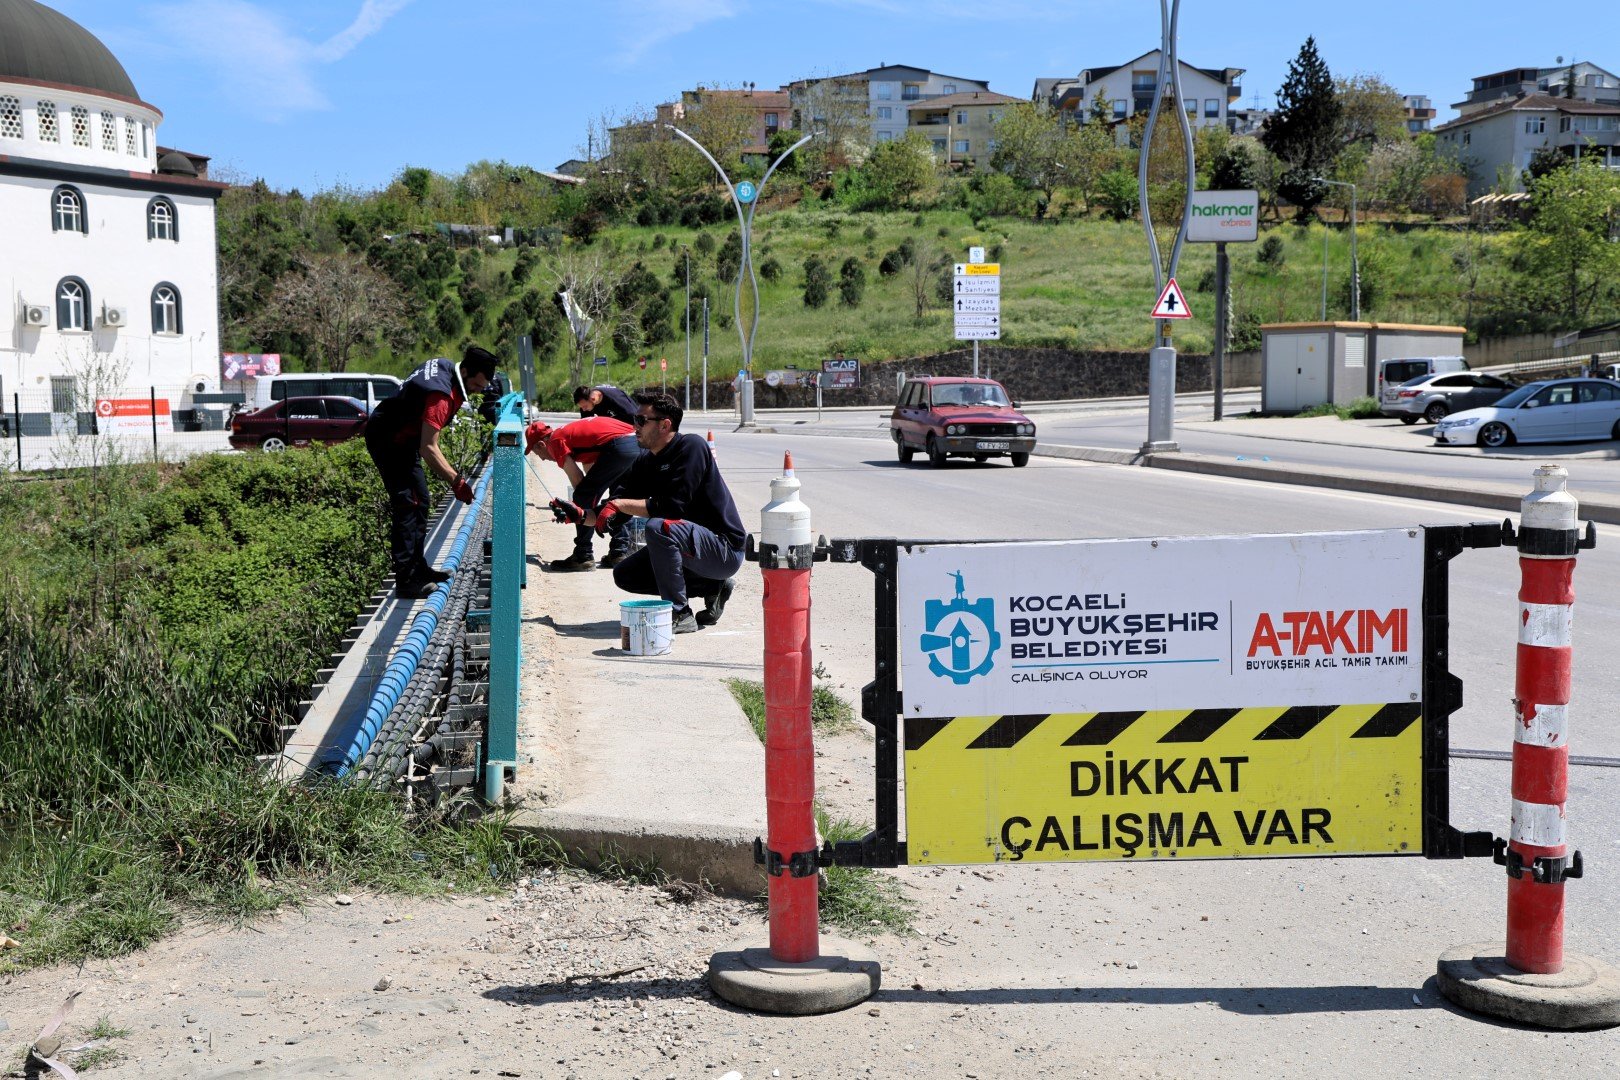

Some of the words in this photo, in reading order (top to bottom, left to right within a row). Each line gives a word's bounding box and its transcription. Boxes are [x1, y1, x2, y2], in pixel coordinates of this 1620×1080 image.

[1192, 204, 1254, 216] hakmar
[1220, 218, 1252, 227] express
[1009, 593, 1126, 612] KOCAELİ
[1010, 612, 1219, 637] BÜYÜKŞEHİR
[1247, 608, 1409, 657] A-TAKIMI
[1011, 638, 1167, 659] BELEDİYESİ
[1246, 658, 1311, 671] BÜYÜKŞEHİR
[1314, 657, 1338, 668] ACİL
[1342, 656, 1372, 667] TAMİR
[1374, 655, 1408, 666] TAKIMI
[1011, 671, 1085, 684] ÇALIŞINCA
[1089, 669, 1148, 680] OLUYOR
[1069, 750, 1250, 798] DİKKAT
[1000, 811, 1223, 861] ÇALIŞMA
[1232, 807, 1335, 847] VAR
